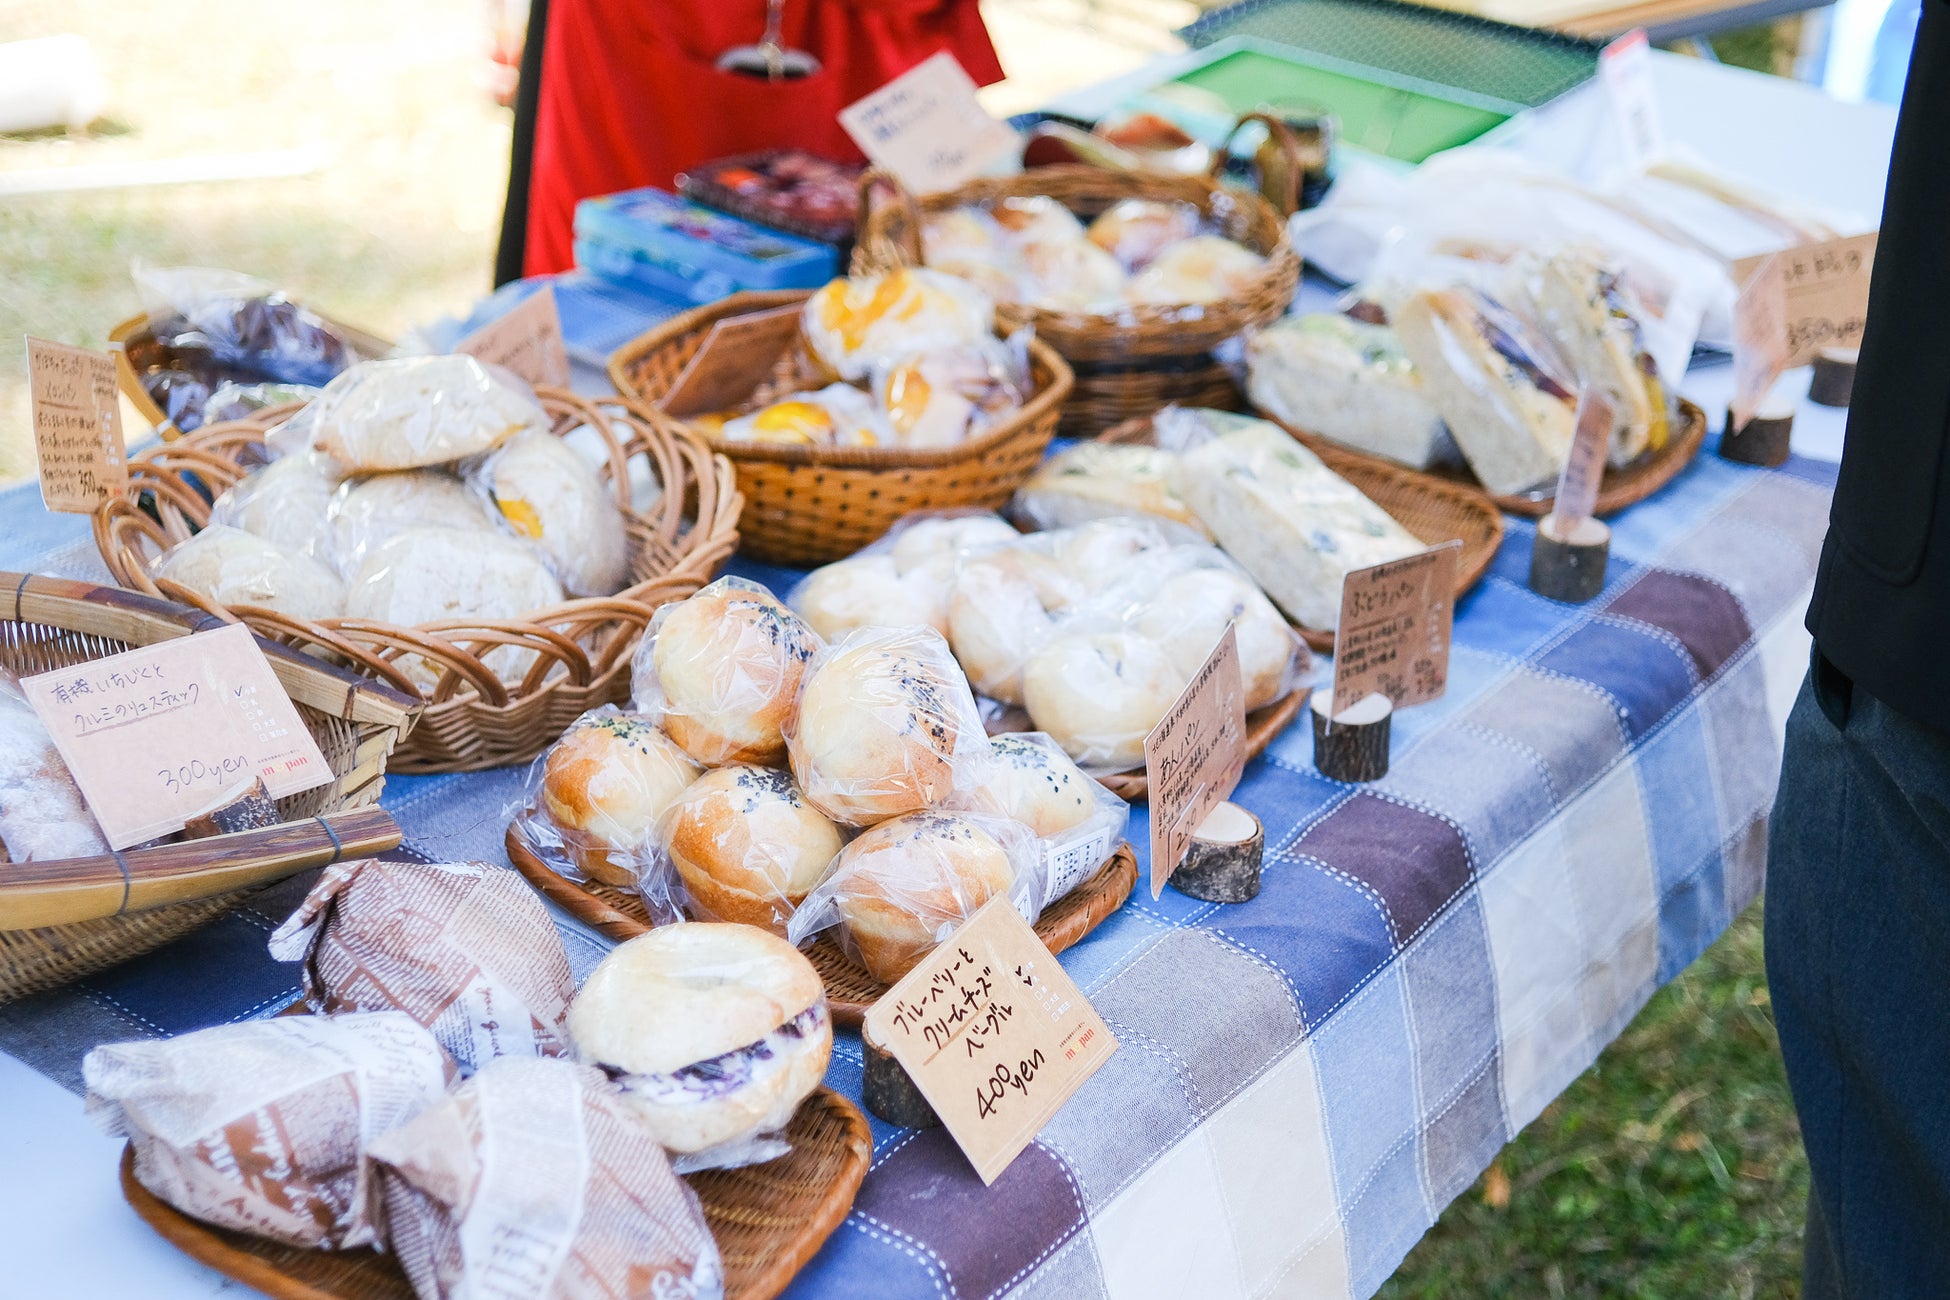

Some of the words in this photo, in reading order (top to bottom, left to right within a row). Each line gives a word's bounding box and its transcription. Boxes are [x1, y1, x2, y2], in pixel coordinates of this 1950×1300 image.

[74, 683, 200, 733] クルミのリュスティック
[1160, 720, 1200, 786] あんパン
[893, 948, 975, 1035] ブルーベリーと
[922, 966, 993, 1051] クリームチーズ
[966, 1003, 1013, 1058] ベーグル
